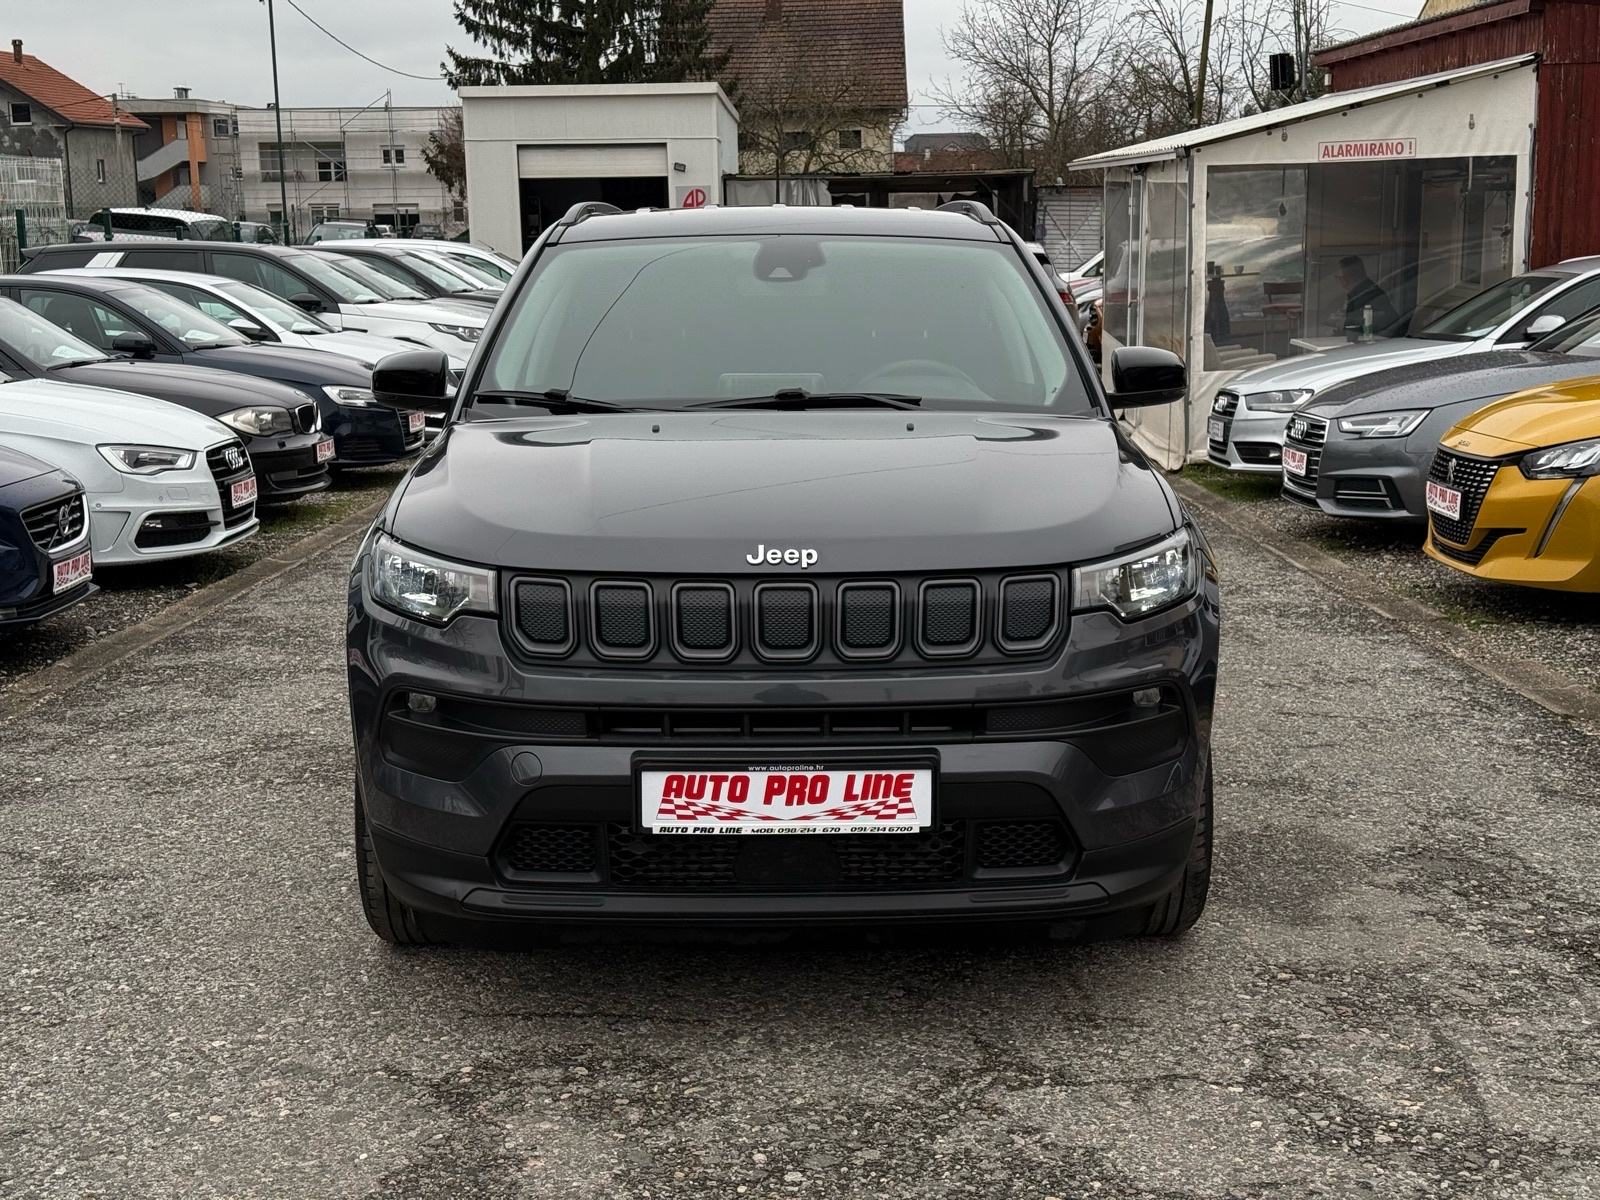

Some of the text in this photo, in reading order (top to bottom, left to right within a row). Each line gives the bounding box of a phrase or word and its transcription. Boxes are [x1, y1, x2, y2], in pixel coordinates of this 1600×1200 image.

[1322, 142, 1404, 158] ALARMIRANO
[746, 544, 818, 569] Jeep
[748, 764, 824, 772] www.autoproline.hr
[662, 773, 915, 807] AUTO PRO LINE
[659, 826, 689, 834] AUTO
